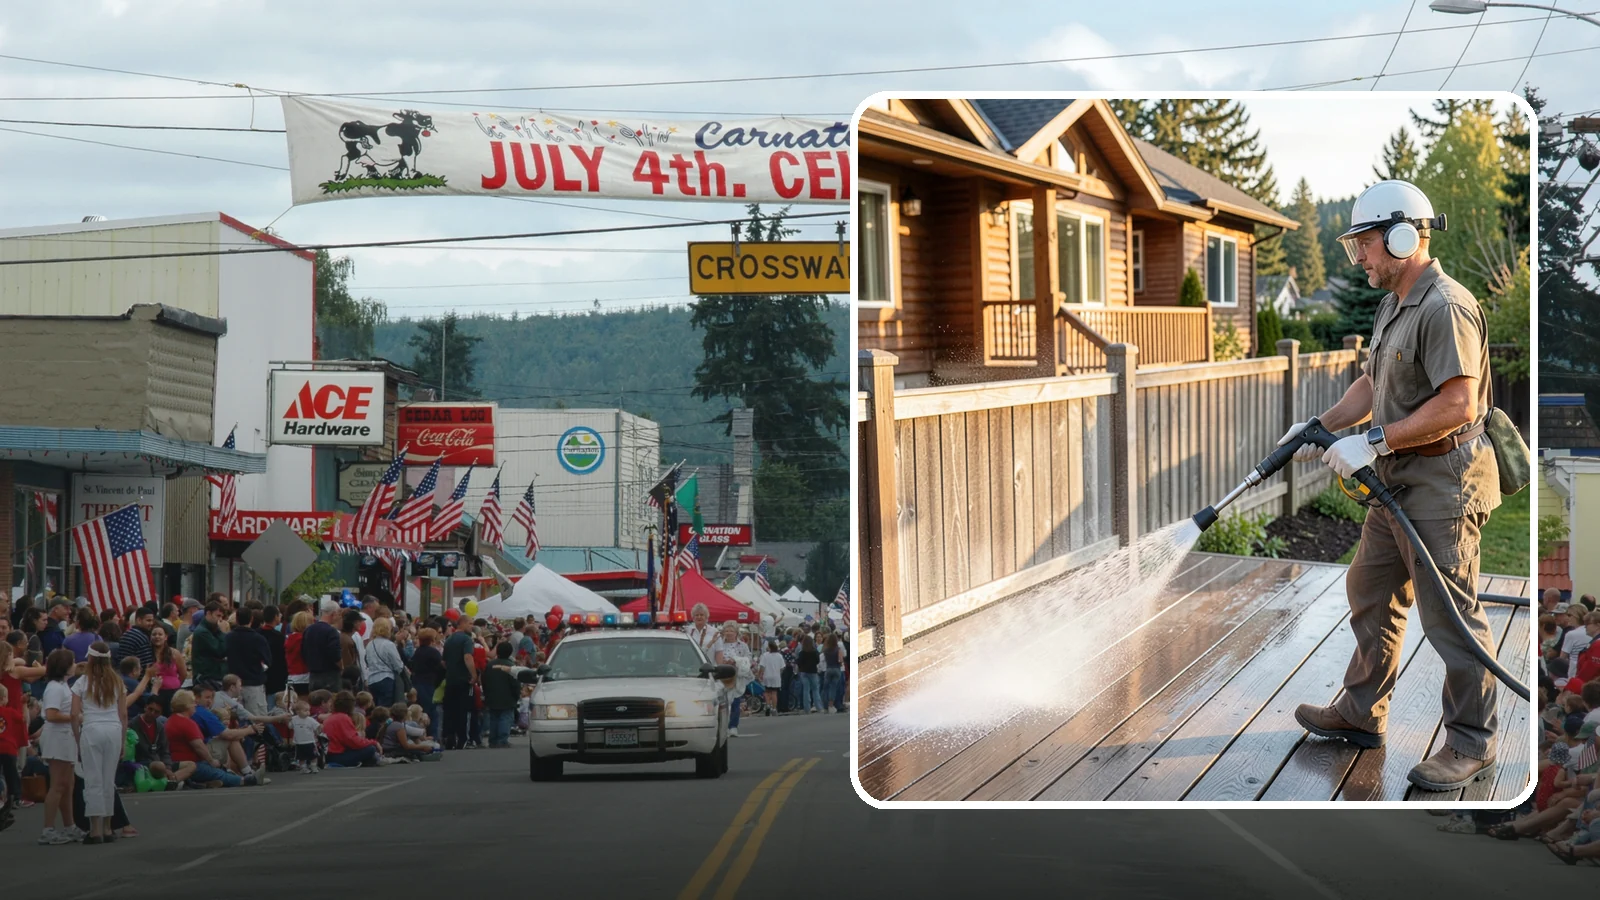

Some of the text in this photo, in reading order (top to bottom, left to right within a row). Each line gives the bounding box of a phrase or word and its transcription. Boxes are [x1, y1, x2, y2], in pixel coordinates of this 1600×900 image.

[695, 121, 850, 149] Carnat
[481, 140, 605, 191] JULY
[632, 150, 746, 198] 4th.
[696, 254, 850, 280] CROSSWA
[283, 380, 374, 420] ACE
[406, 409, 452, 421] CEDAR
[283, 421, 371, 436] Hardware
[416, 428, 477, 447] Coca-Cola
[96, 486, 124, 495] Vincent
[126, 485, 136, 495] de
[137, 486, 155, 496] Paul
[688, 526, 741, 535] CRNATION
[699, 535, 730, 543] GLASS
